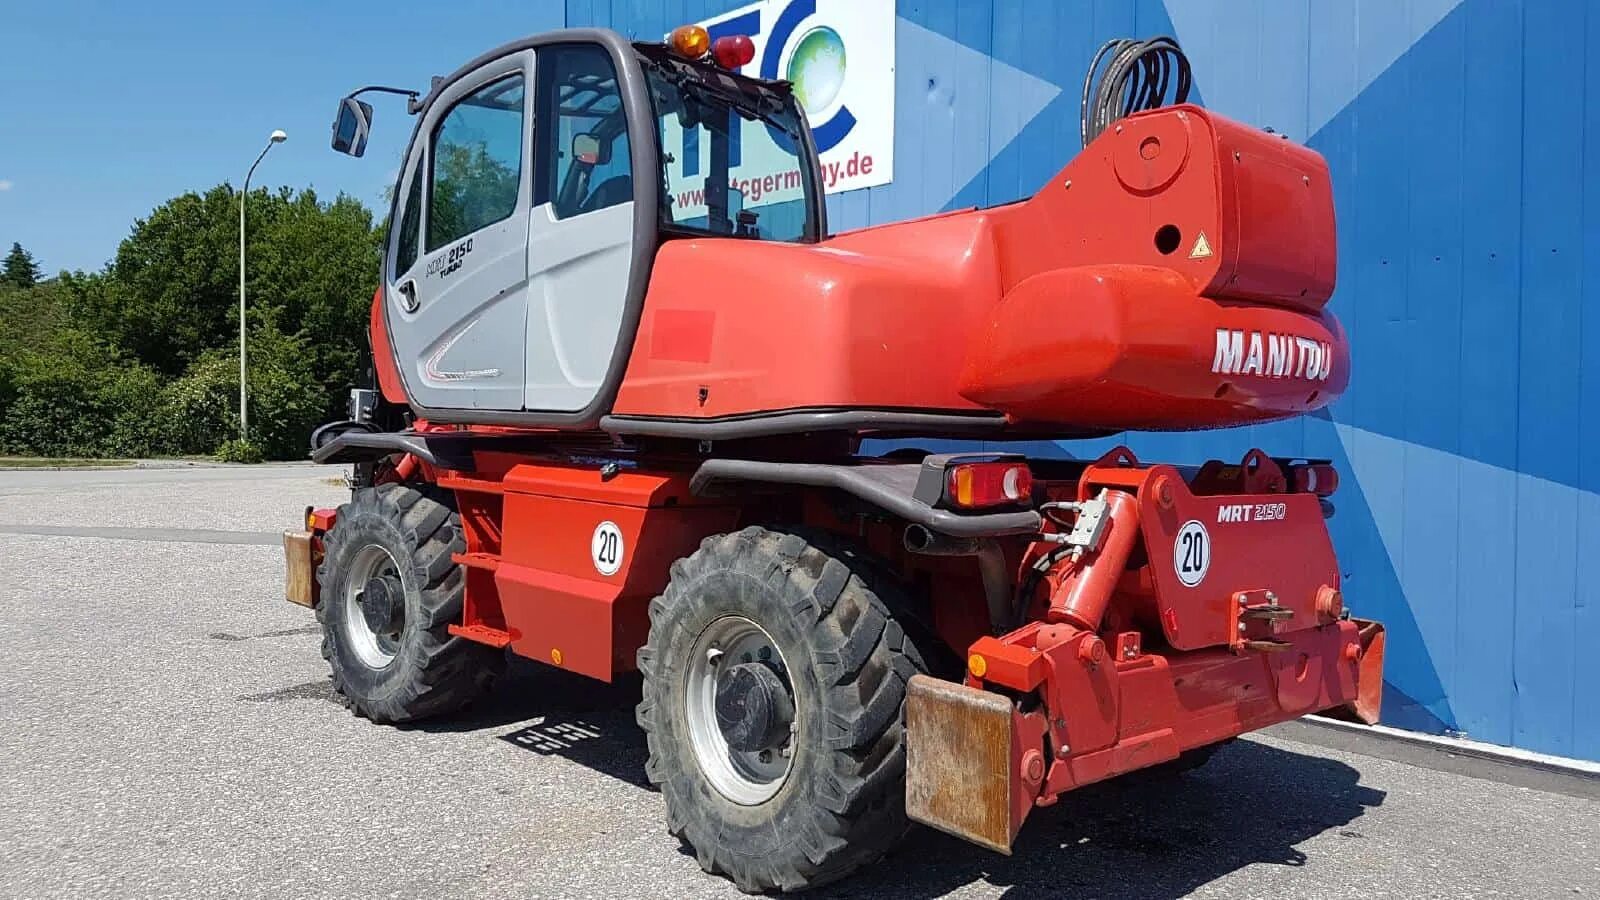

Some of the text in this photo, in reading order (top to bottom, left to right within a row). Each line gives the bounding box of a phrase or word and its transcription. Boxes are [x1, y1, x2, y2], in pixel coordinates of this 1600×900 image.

[449, 238, 473, 264] 2150
[1211, 328, 1332, 381] MANITOU
[1217, 503, 1286, 523] MRT 2150
[599, 530, 617, 564] 20
[1182, 532, 1203, 572] 20
